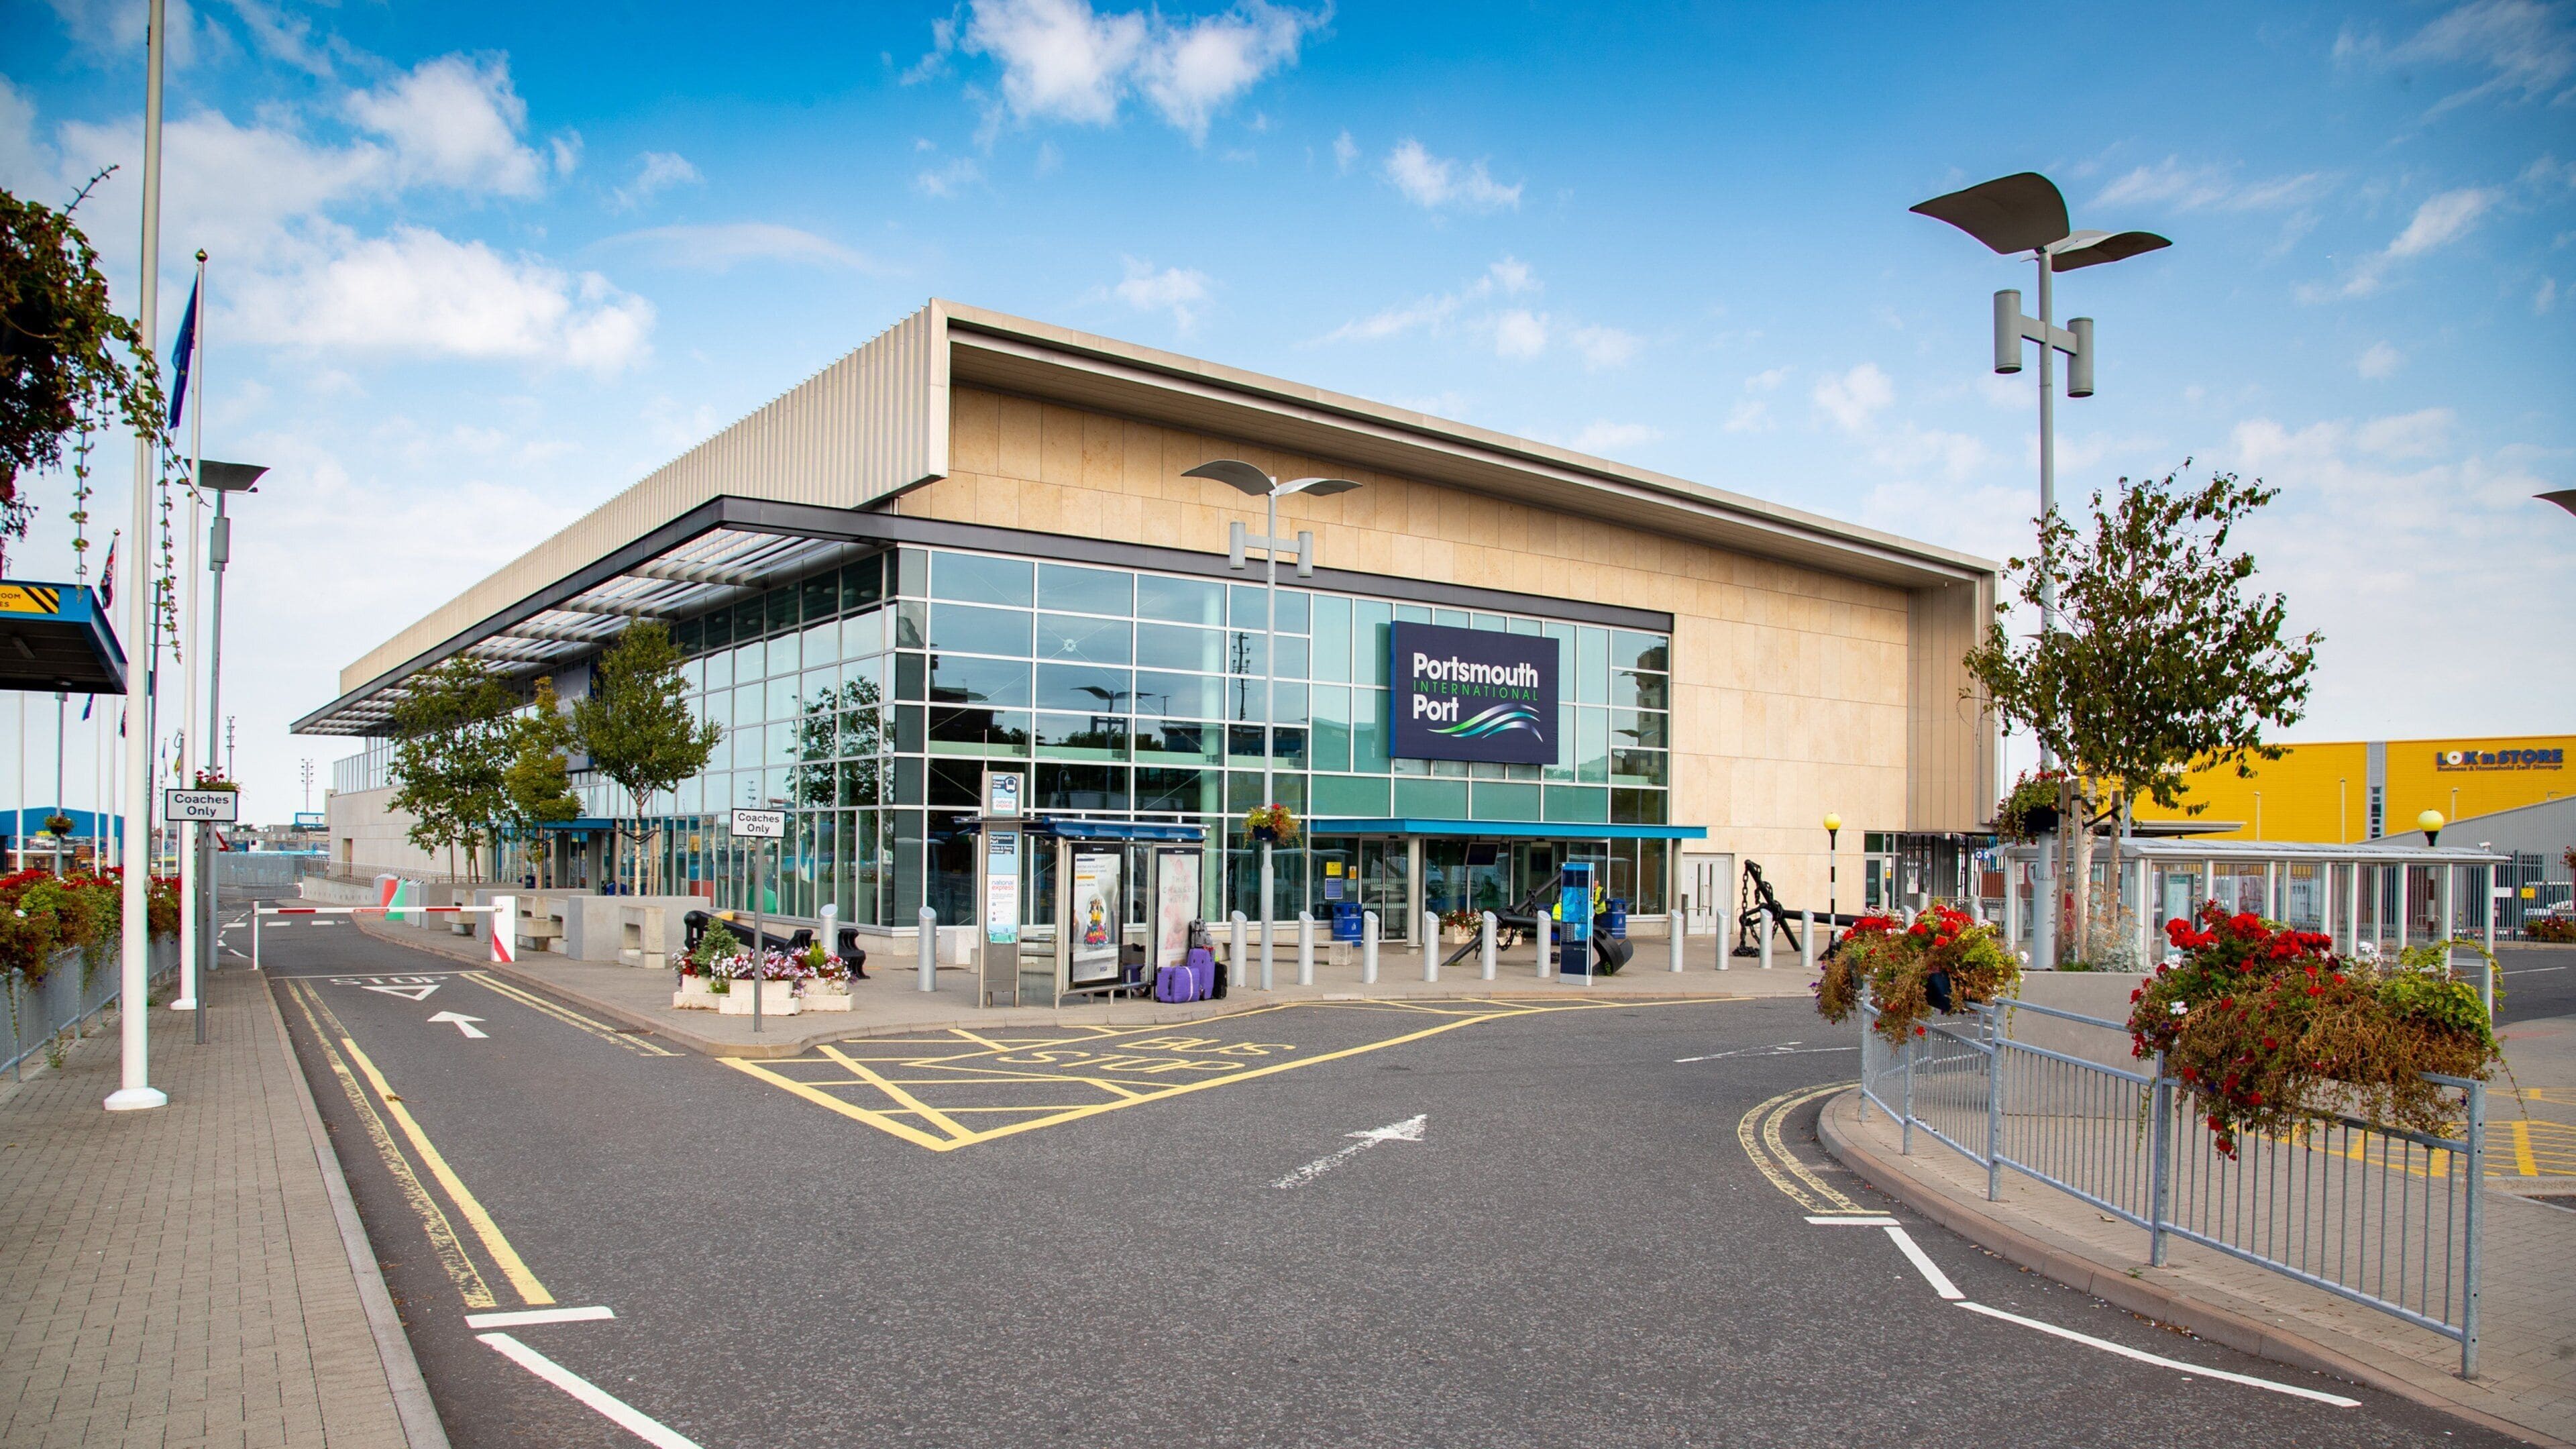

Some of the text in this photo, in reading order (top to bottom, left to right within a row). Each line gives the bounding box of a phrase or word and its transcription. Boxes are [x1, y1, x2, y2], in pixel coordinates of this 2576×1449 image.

[1413, 652, 1538, 688] Portsmouth
[1413, 680, 1538, 701] INTERNATIONAL
[1413, 694, 1459, 722] Port
[175, 794, 229, 804] Coaches
[187, 806, 217, 817] Only
[738, 812, 780, 823] Coaches
[747, 823, 770, 834] Only
[329, 976, 449, 985] STOP
[1116, 1036, 1297, 1056] BUS
[997, 1051, 1246, 1073] STOP
